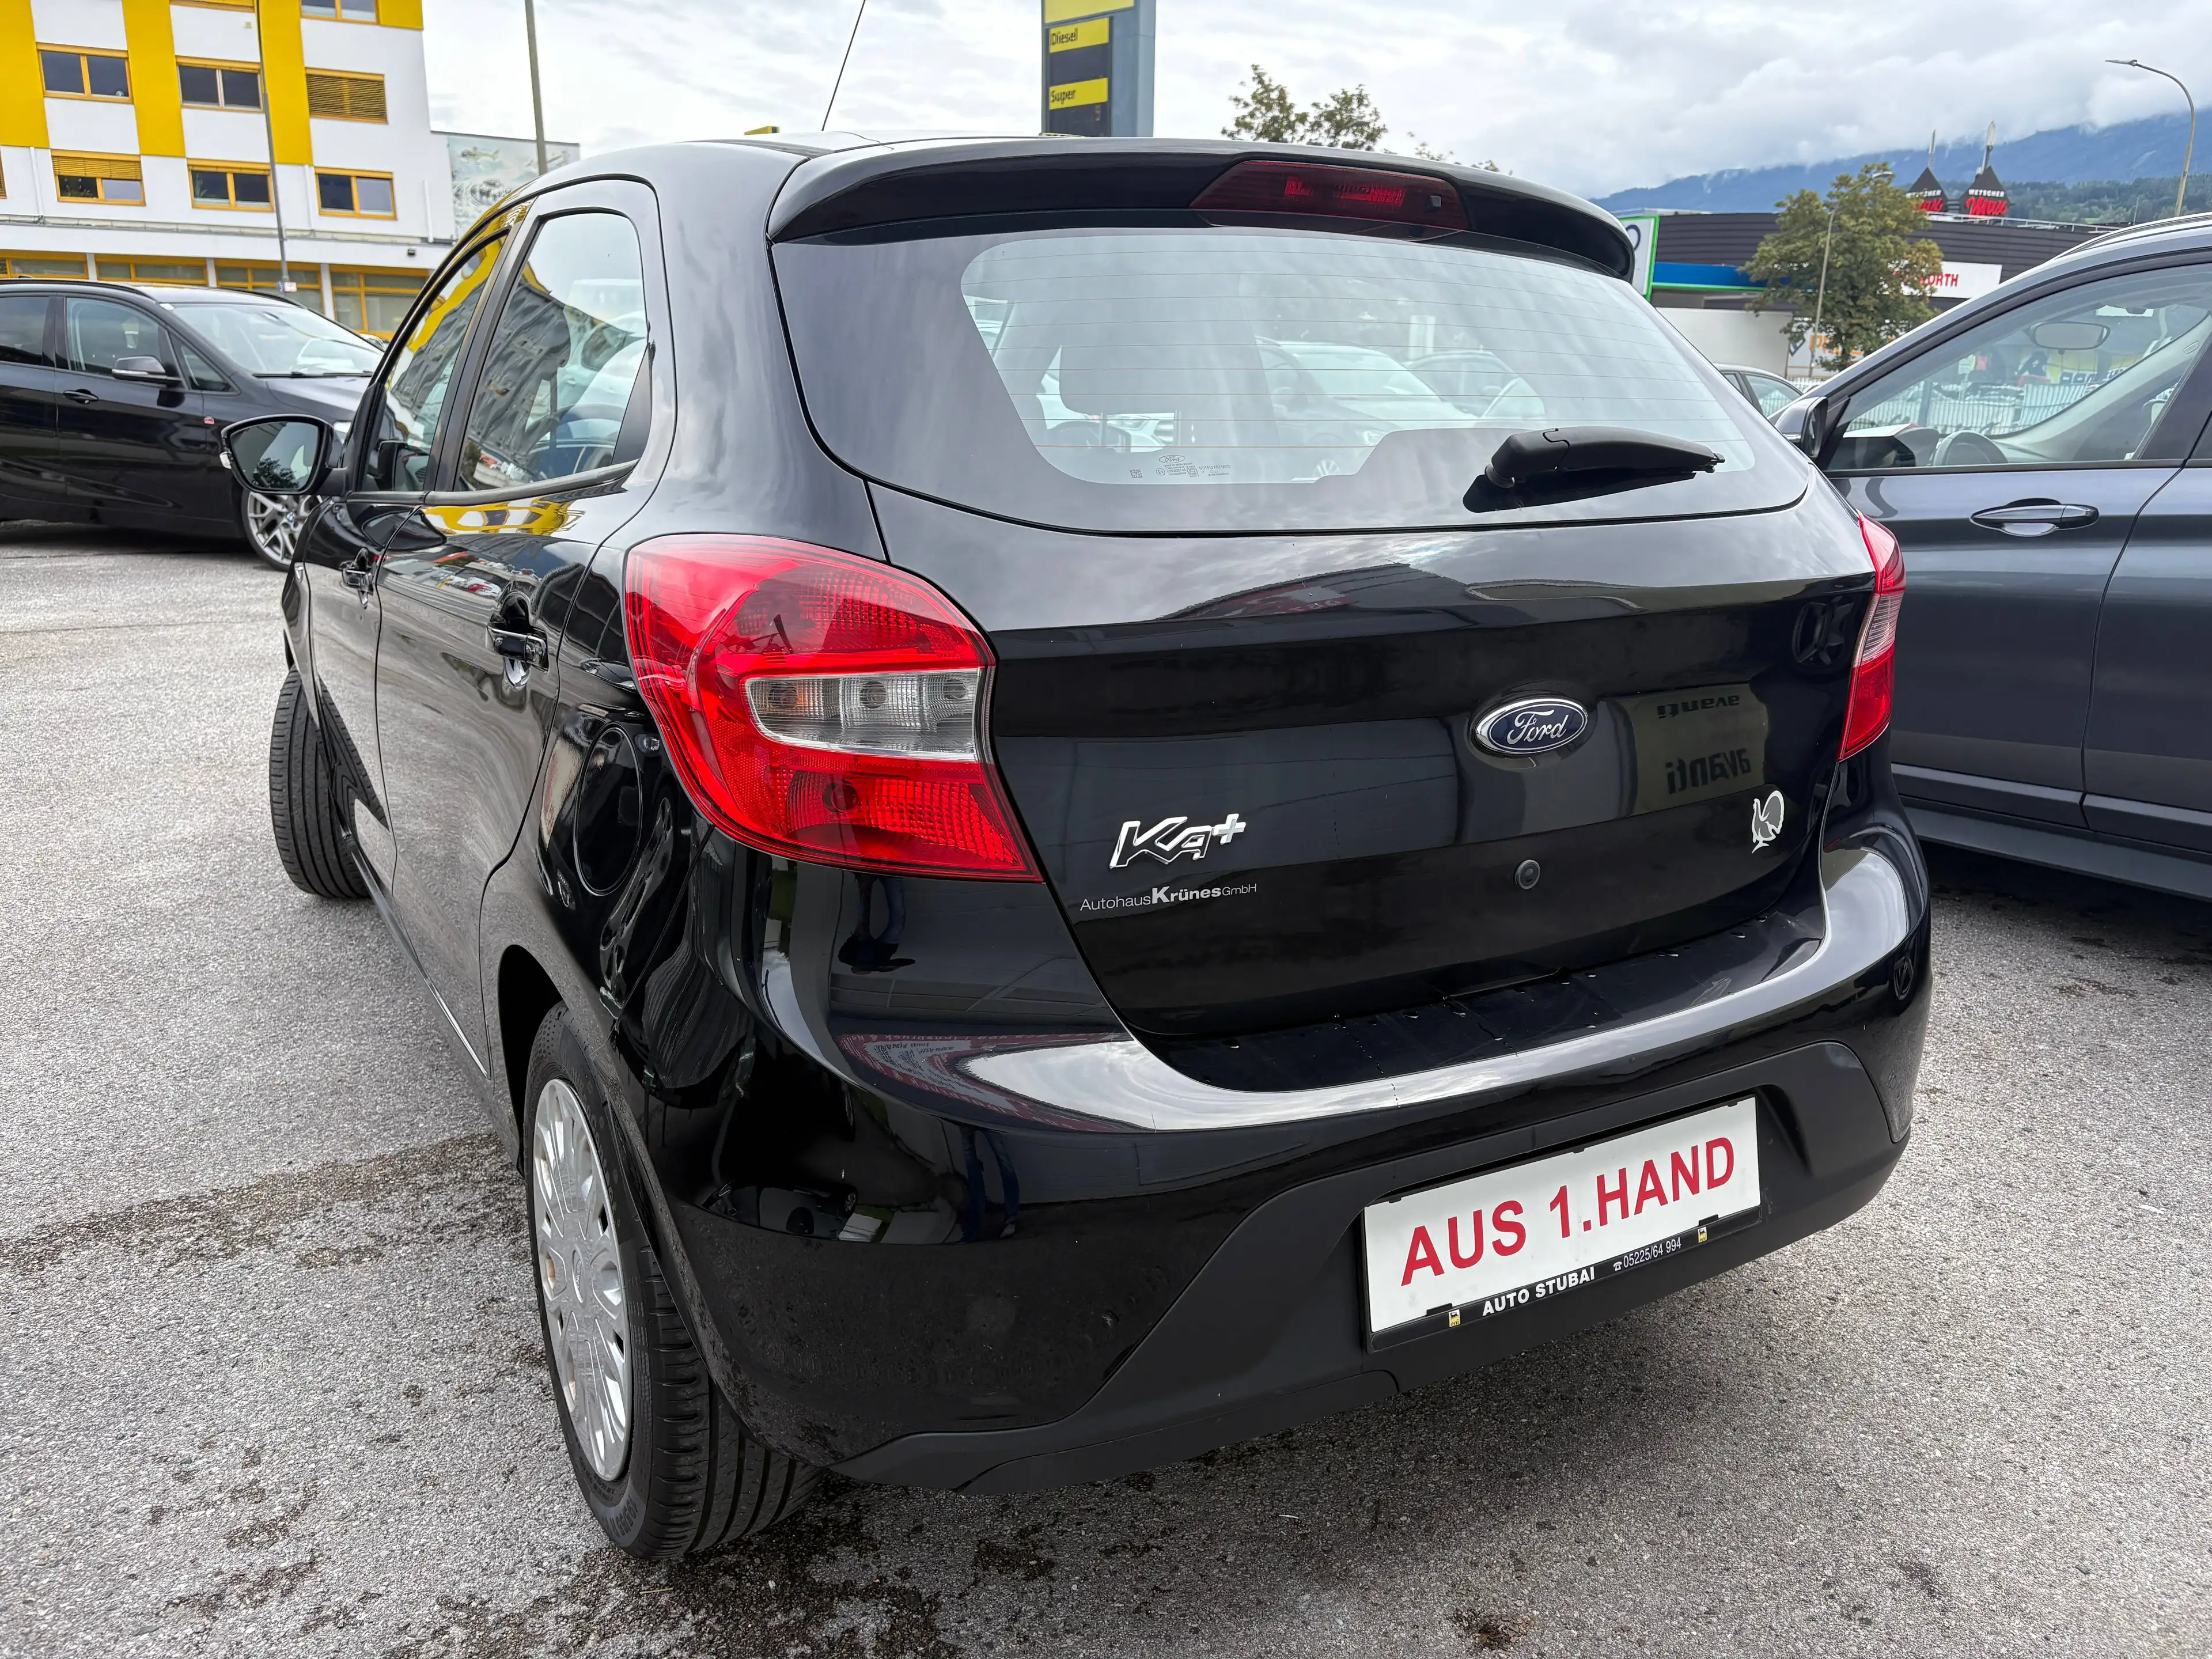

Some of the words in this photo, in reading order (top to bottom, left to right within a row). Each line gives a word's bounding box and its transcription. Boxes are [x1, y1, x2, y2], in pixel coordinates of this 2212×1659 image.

[1050, 28, 1078, 46] Diesel
[1050, 89, 1076, 104] Super
[1965, 195, 2009, 216] Max
[1968, 188, 2005, 197] WETSCHER
[1506, 709, 1569, 744] Ford
[1401, 1200, 1527, 1286] AUS
[1550, 1137, 1735, 1238] 1.HAND
[1623, 1243, 1664, 1268] 05225/64
[1665, 1236, 1682, 1254] 994
[1482, 1289, 1530, 1317] AUTO
[1535, 1266, 1596, 1298] STUBAI
